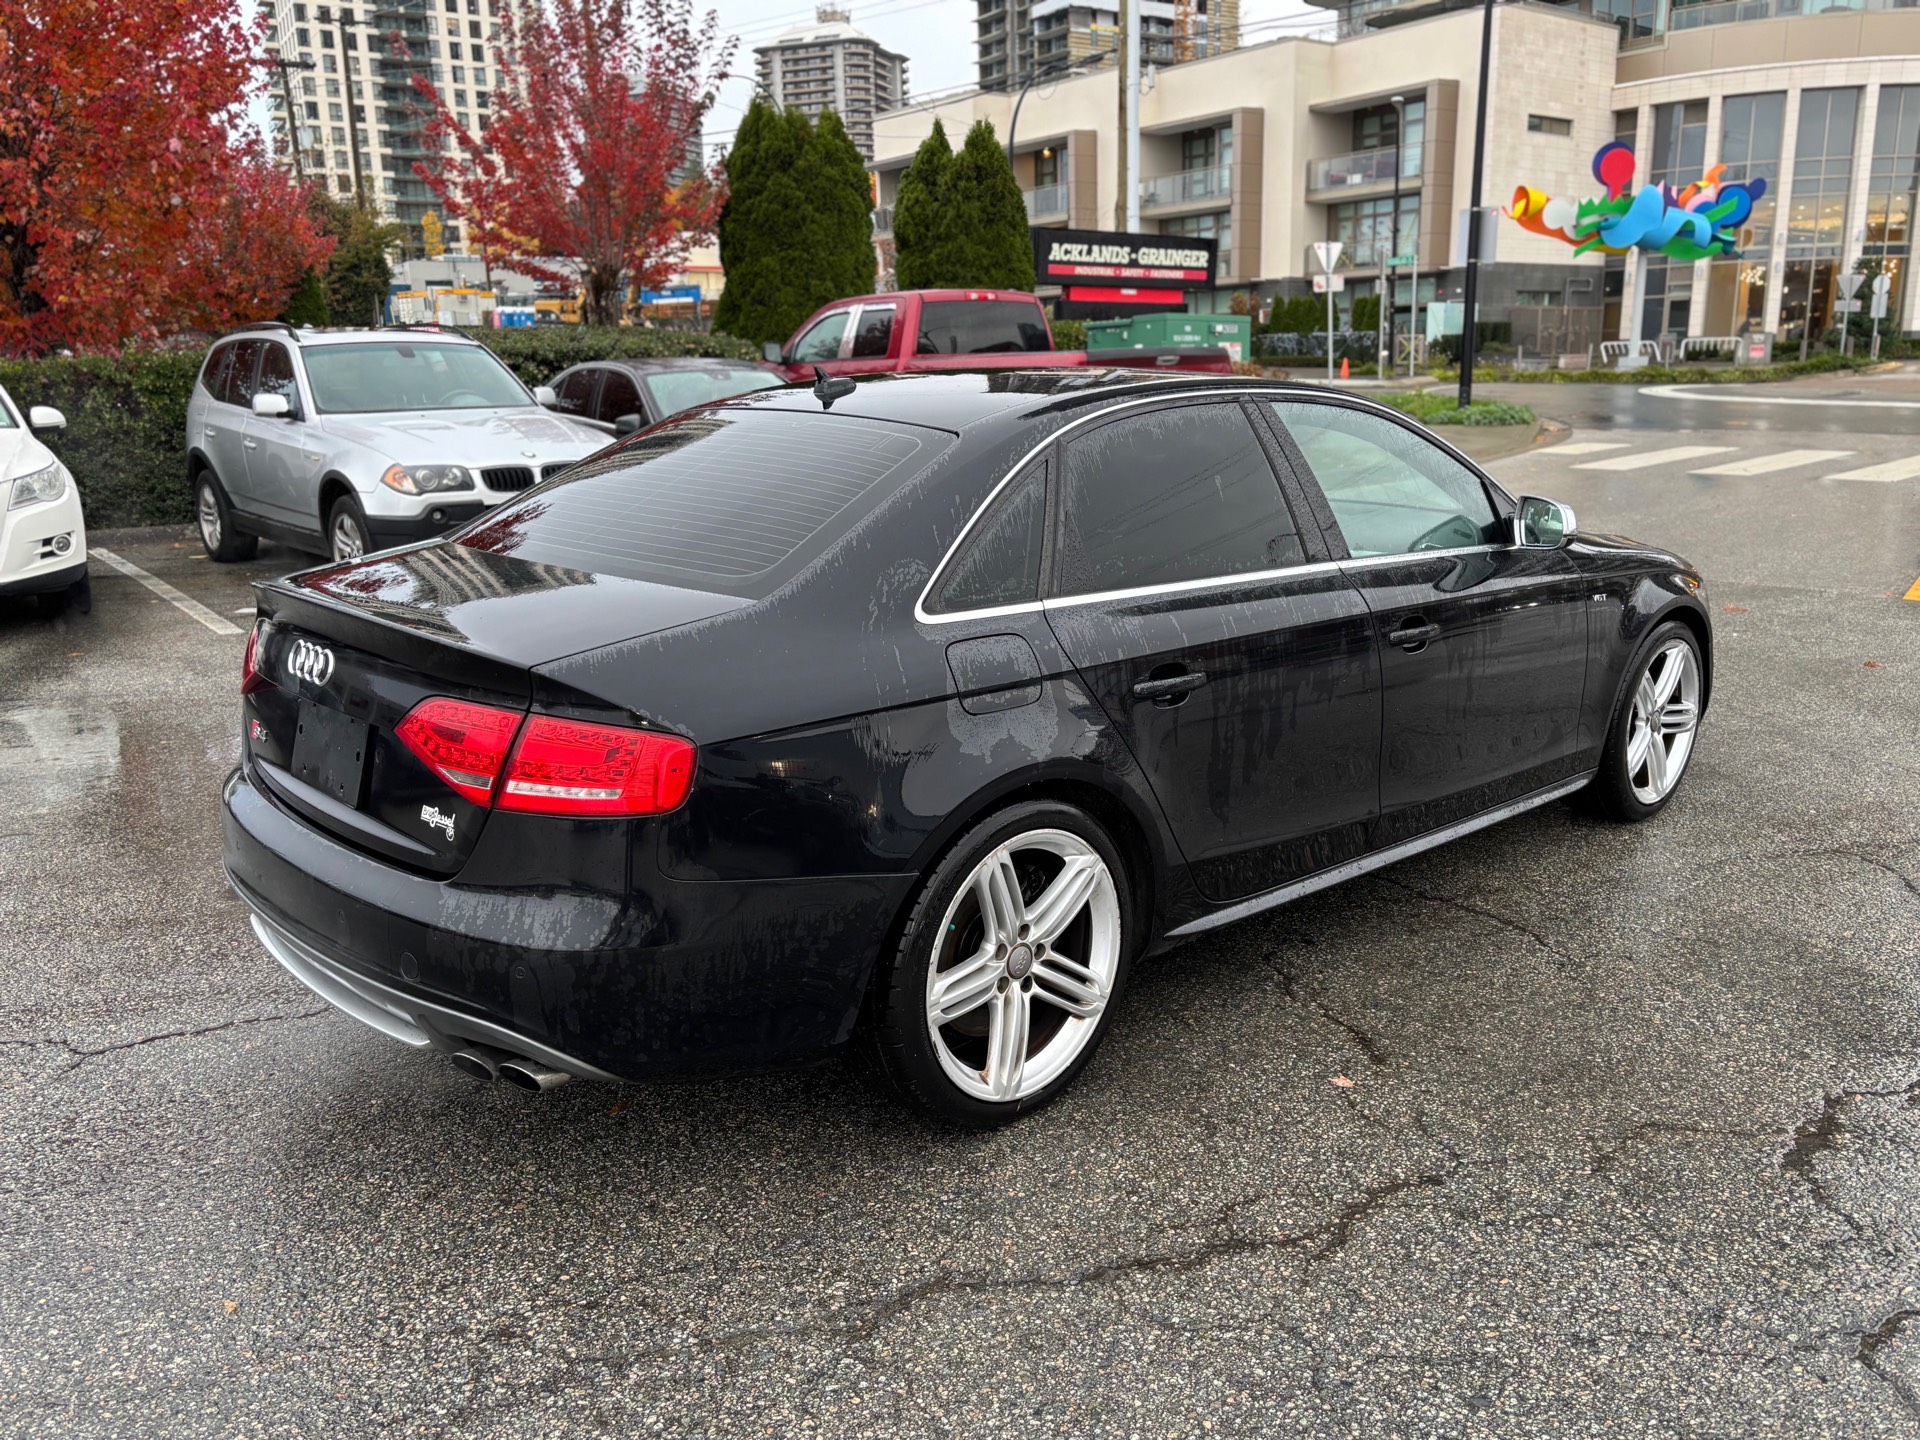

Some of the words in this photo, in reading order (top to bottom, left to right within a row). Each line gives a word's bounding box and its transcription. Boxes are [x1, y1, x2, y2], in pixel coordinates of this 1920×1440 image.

[1074, 267, 1115, 277] INDUSTRIAL
[1121, 268, 1144, 278] SAFETY
[1150, 269, 1184, 279] FASTENERS
